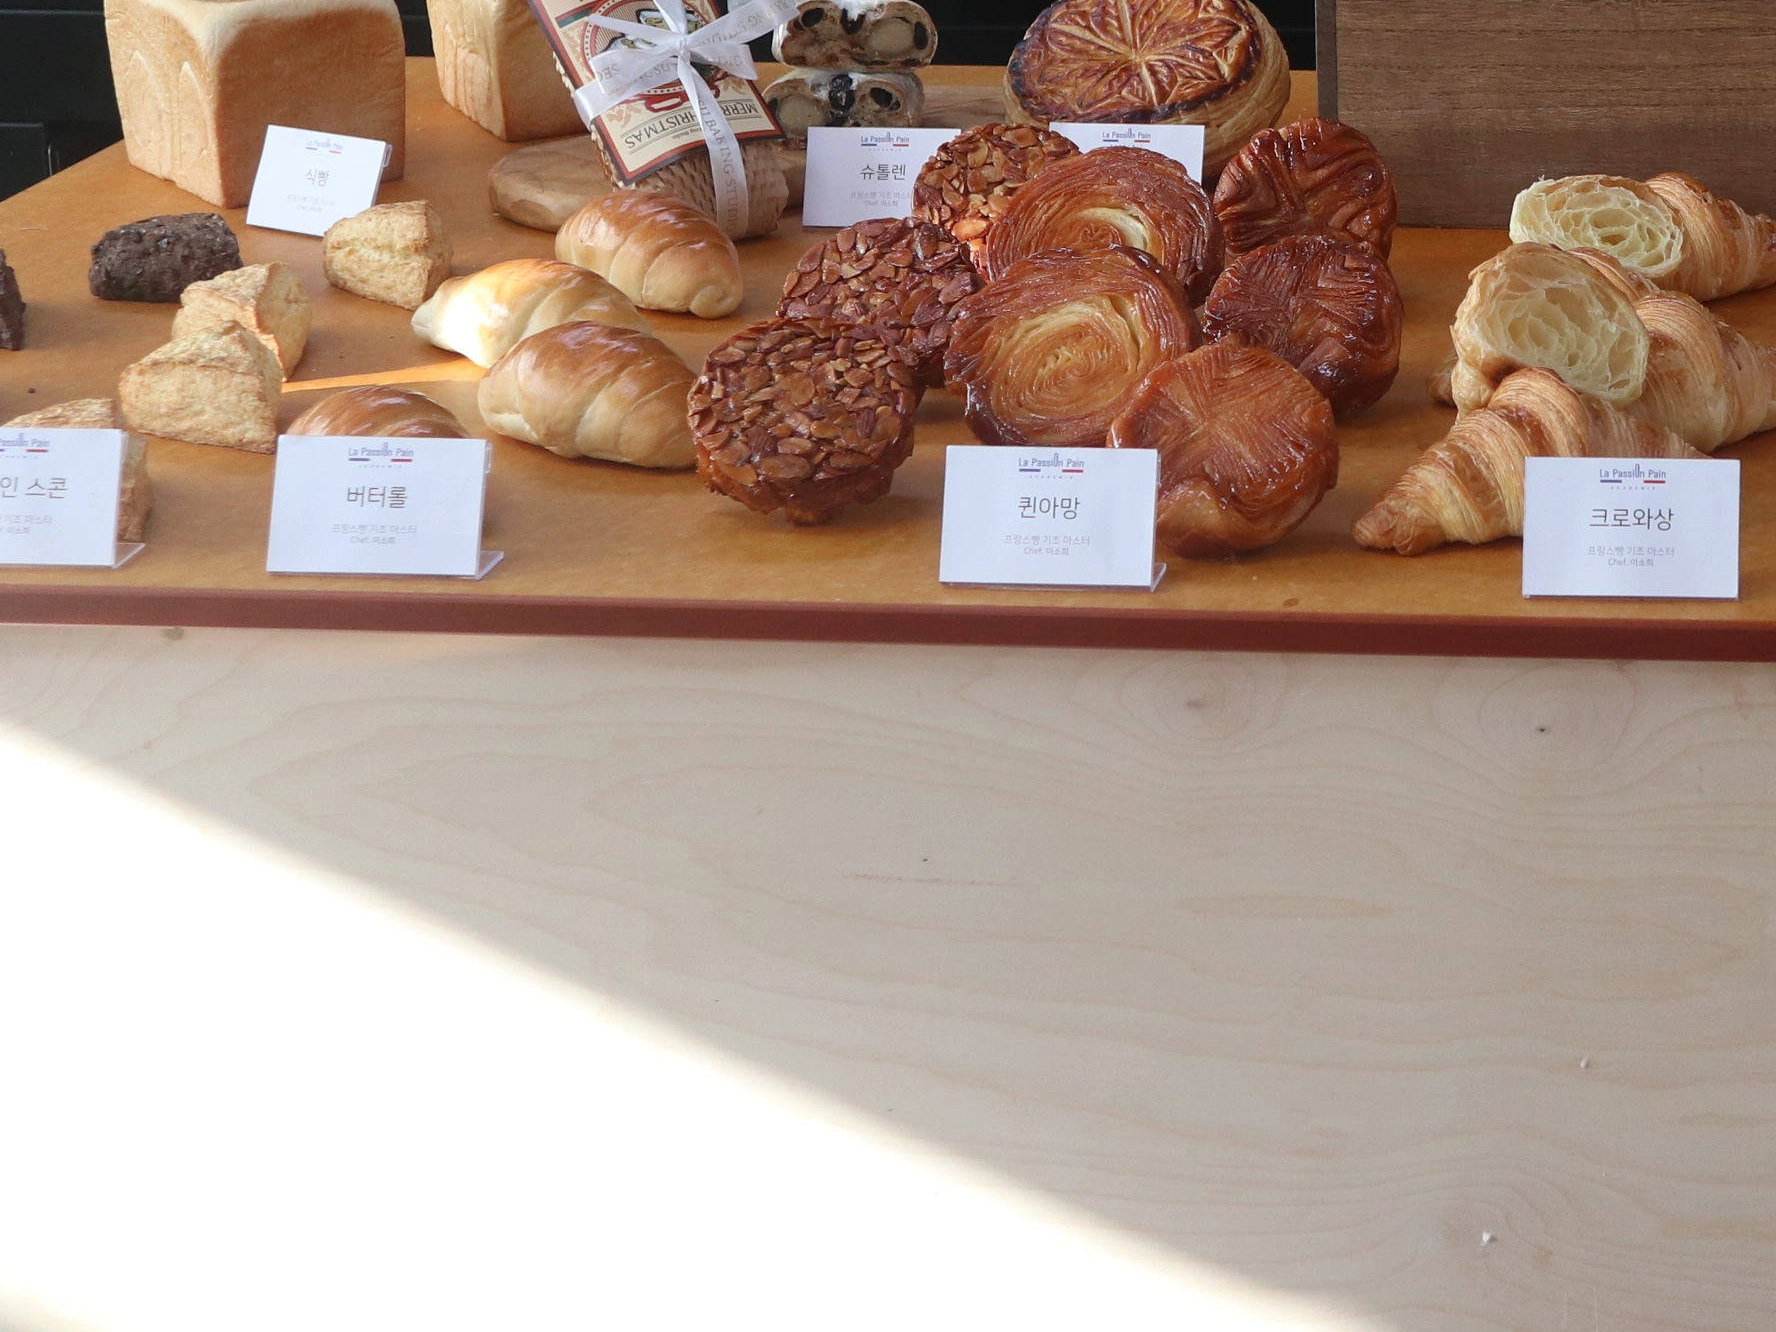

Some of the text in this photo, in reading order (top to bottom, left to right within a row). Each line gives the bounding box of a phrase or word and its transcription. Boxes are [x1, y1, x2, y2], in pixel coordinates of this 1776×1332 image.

[870, 132, 894, 143] Passion
[1112, 128, 1136, 139] Passion
[305, 168, 329, 187] 식빵
[705, 118, 736, 175] BAKING
[724, 177, 739, 233] STUDIO
[860, 164, 906, 181] 슈톨렌
[348, 442, 414, 457] La Passion Pain
[1019, 452, 1084, 468] La Passion Pain
[1600, 463, 1666, 479] La Passion Pain
[25, 477, 69, 499] 스콘
[346, 486, 408, 509] 버터롤
[1018, 496, 1081, 520] 퀸아망
[1589, 508, 1674, 531] 크로와상
